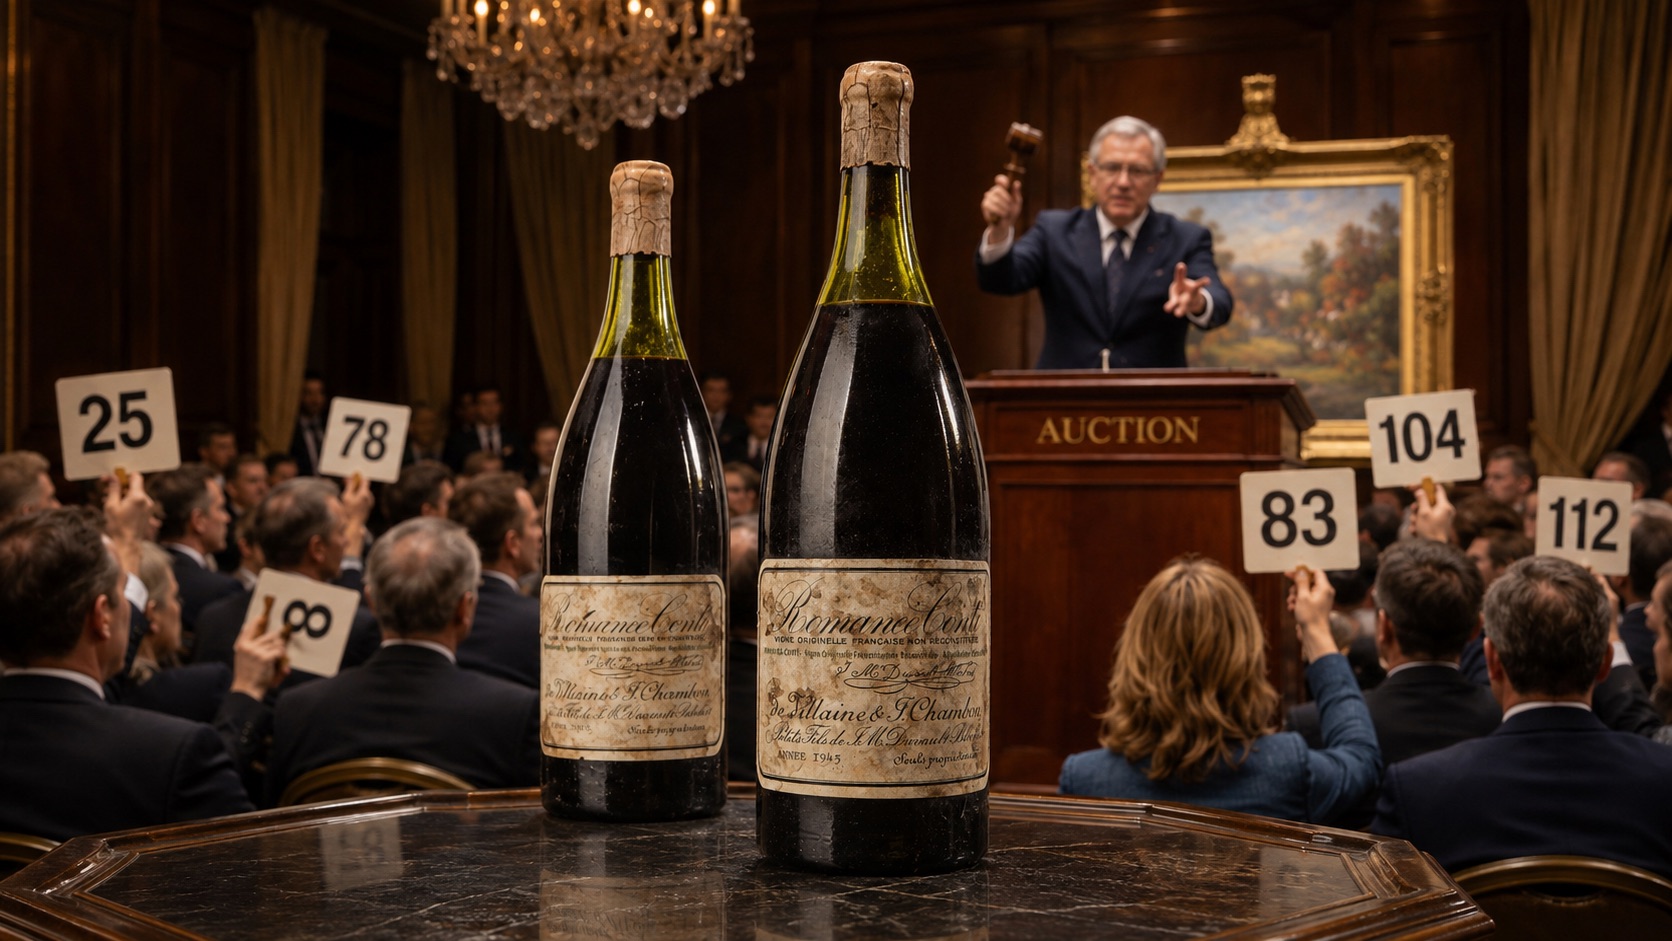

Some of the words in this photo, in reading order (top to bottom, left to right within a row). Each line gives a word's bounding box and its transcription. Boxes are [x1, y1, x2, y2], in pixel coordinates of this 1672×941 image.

[78, 390, 153, 455] 25
[341, 415, 390, 462] 78
[1037, 416, 1200, 445] AUCTION
[1379, 408, 1466, 464] 104
[1260, 488, 1338, 549] 83
[1549, 496, 1619, 552] 112
[284, 600, 332, 639] 8
[907, 637, 927, 645] NON
[868, 705, 885, 722] &
